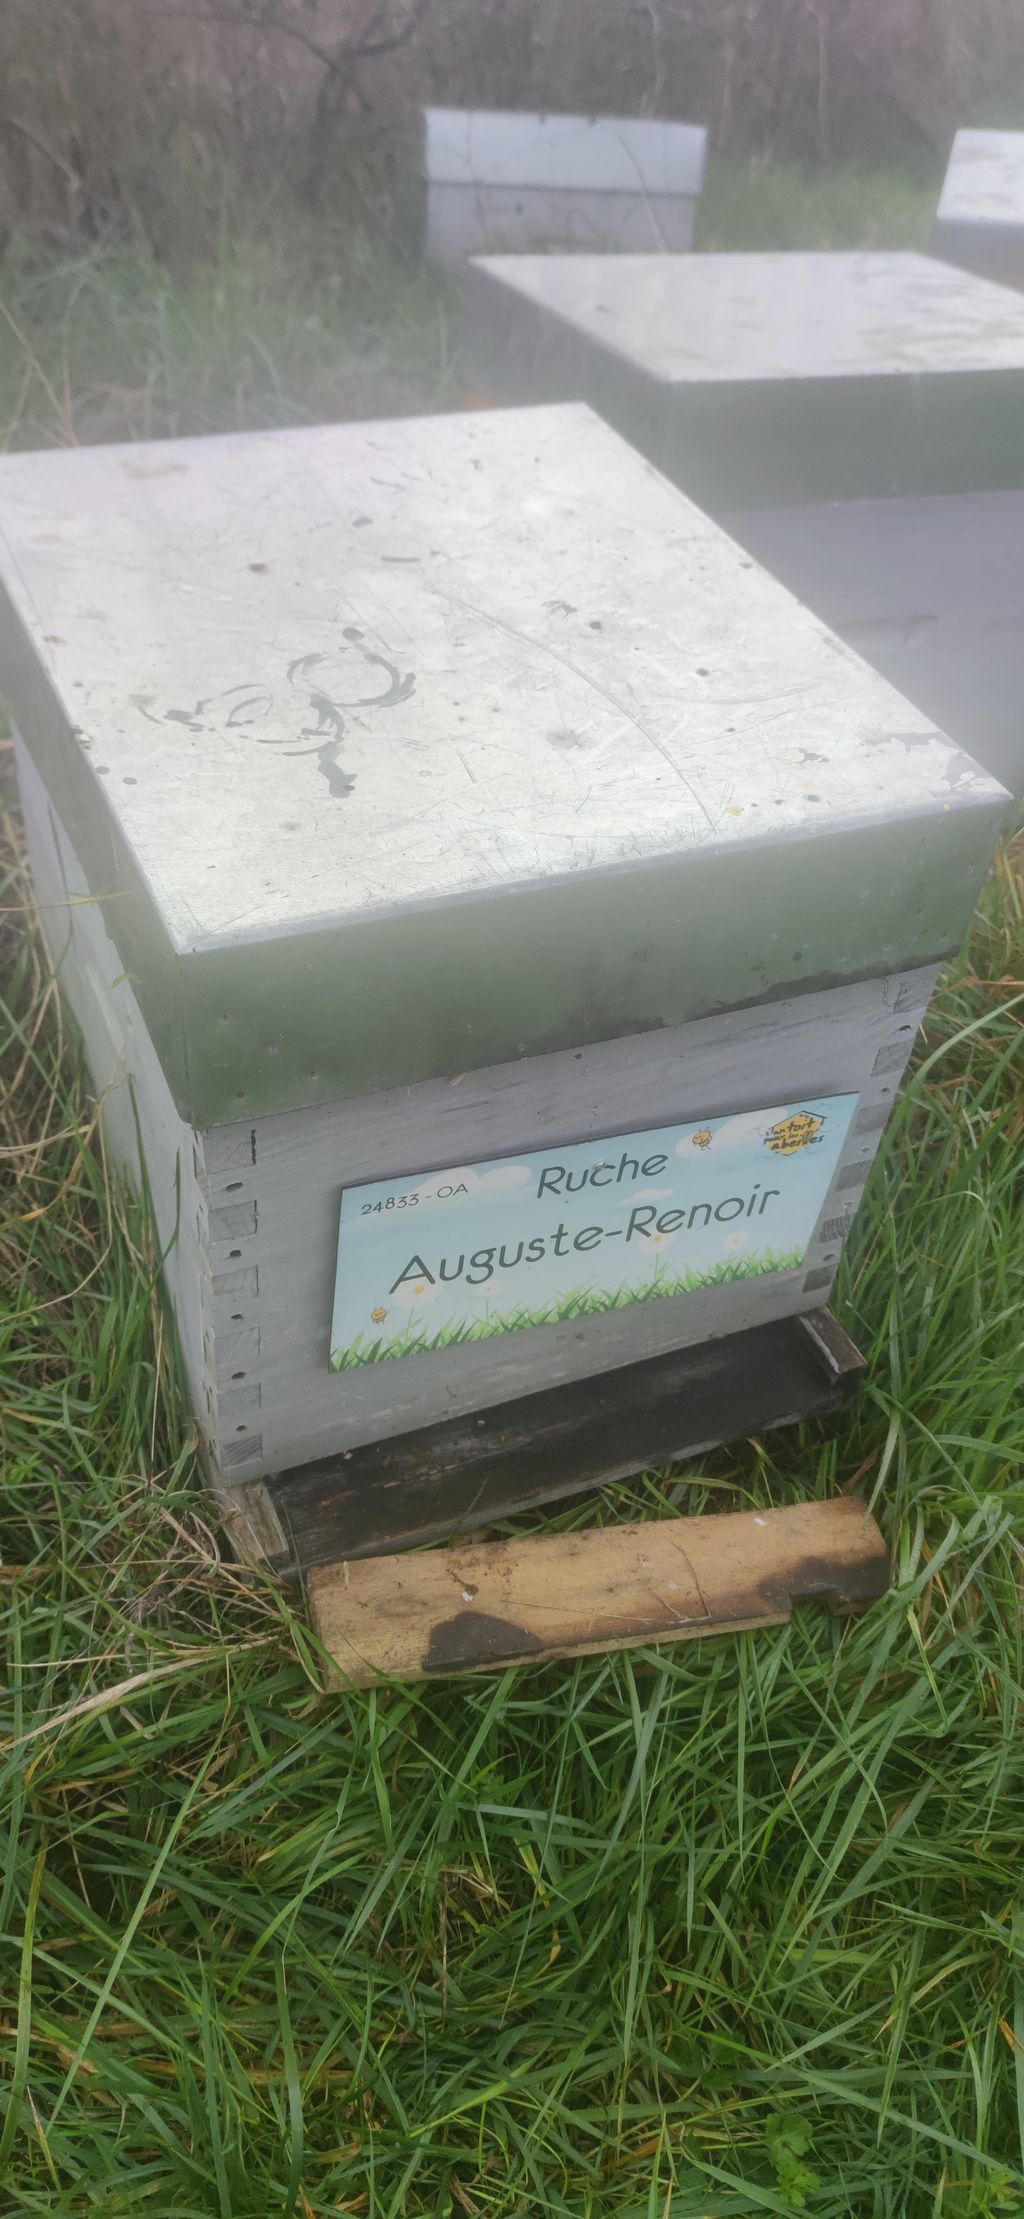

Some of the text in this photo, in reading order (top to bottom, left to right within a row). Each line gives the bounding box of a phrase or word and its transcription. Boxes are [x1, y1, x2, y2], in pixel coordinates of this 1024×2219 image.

[787, 1116, 816, 1132] toit
[771, 1129, 825, 1151] abeilles
[537, 1152, 669, 1199] Ruche
[361, 1193, 420, 1216] 24833
[388, 1183, 781, 1295] Auguste-Renoir
